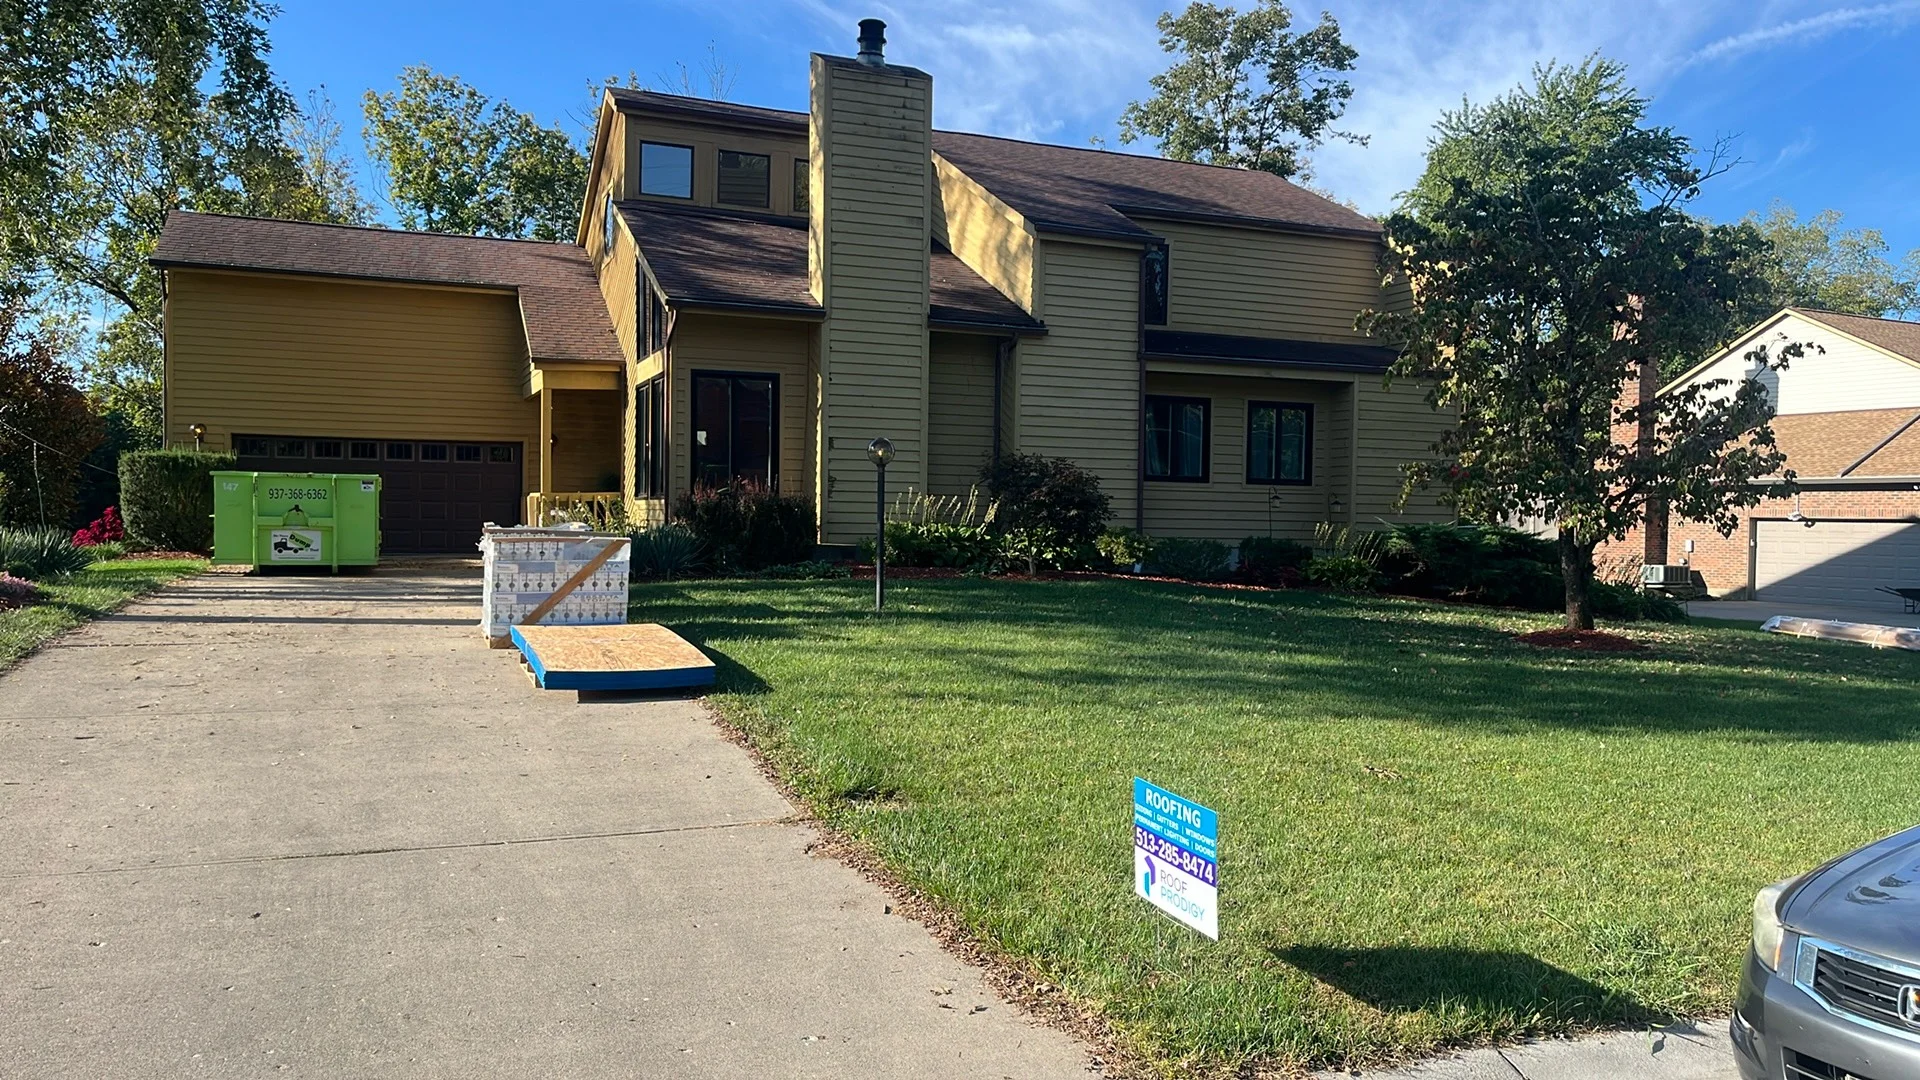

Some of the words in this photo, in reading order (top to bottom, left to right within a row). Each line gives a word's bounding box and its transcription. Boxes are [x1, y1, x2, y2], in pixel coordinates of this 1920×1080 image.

[268, 488, 328, 500] 937-368-6362
[289, 533, 311, 548] Dump
[1145, 787, 1201, 829] ROOFING
[1156, 813, 1179, 831] GUTTERS
[1185, 827, 1215, 848] WINDOWS
[1164, 828, 1190, 847] LIGHTING
[1194, 842, 1215, 859] DOORS
[1136, 828, 1214, 883] 513-285-8474
[1160, 870, 1188, 895] ROOF
[1160, 885, 1206, 922] PRODIGY
